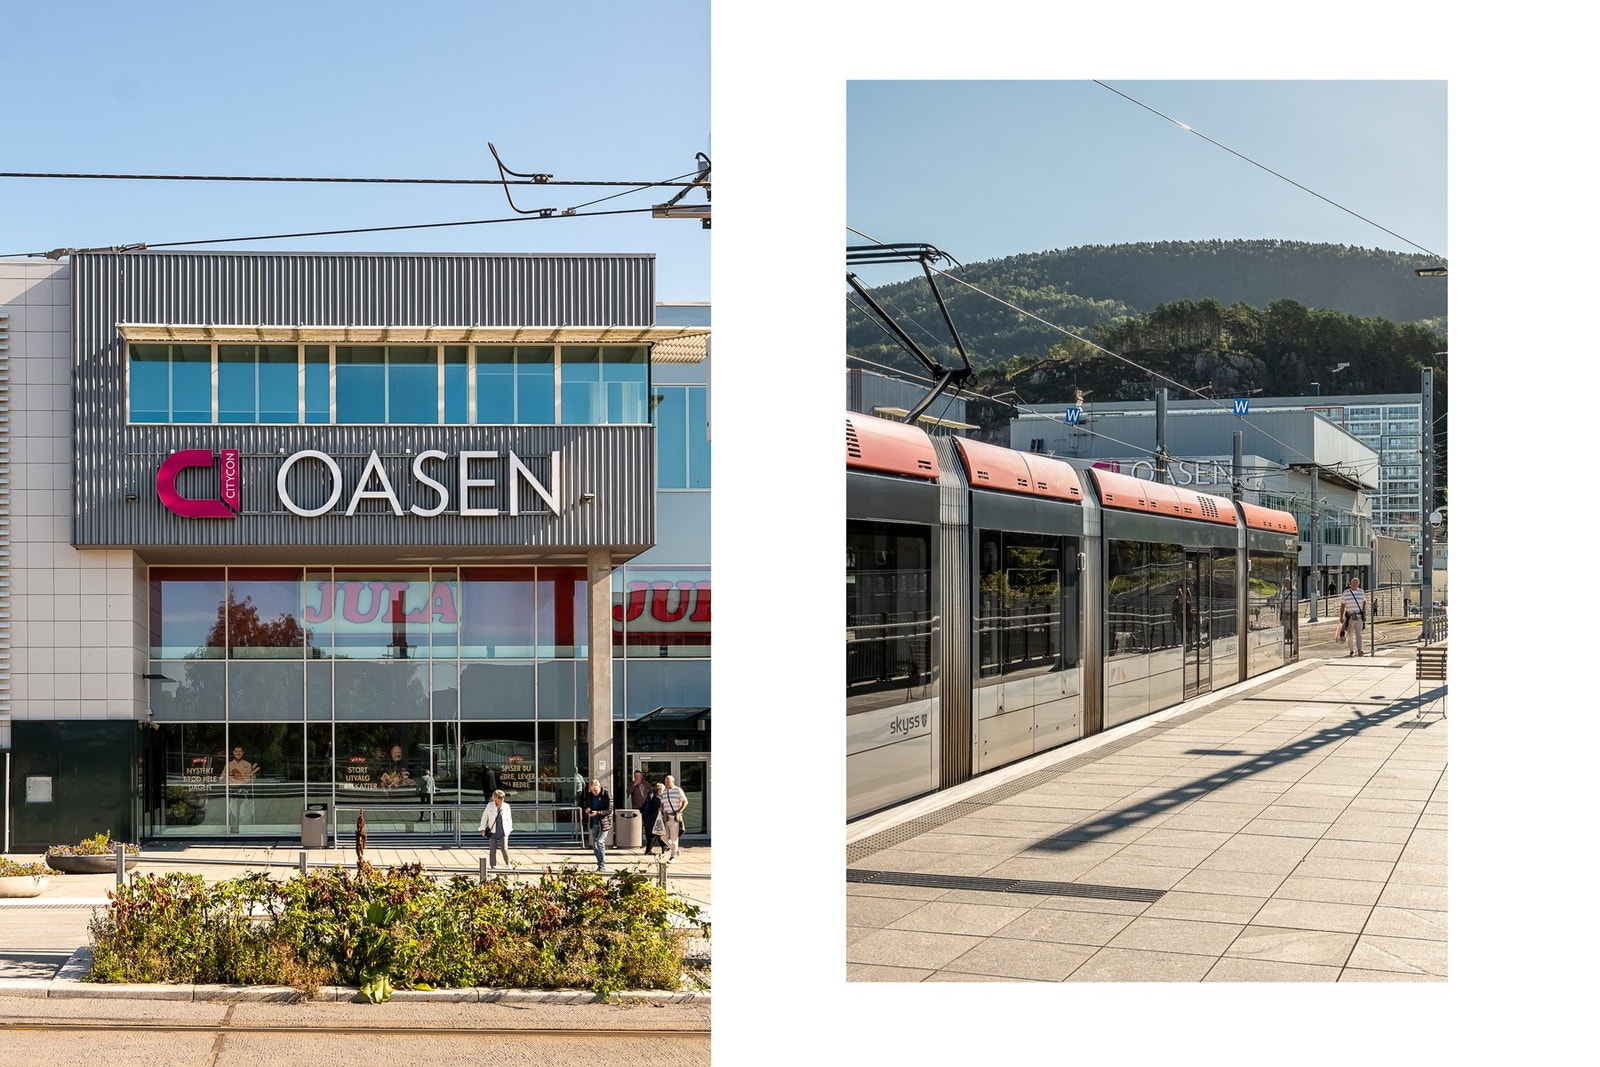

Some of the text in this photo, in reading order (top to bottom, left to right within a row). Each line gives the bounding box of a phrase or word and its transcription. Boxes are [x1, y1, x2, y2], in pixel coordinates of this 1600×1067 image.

[1235, 400, 1248, 414] W
[1067, 409, 1079, 422] W
[225, 452, 236, 499] CITYCON
[276, 449, 560, 517] OASEN
[302, 581, 459, 624] JULA
[890, 715, 920, 735] skyss
[186, 767, 214, 775] NYSTEKT
[347, 766, 368, 774] STORT
[501, 764, 521, 772] SPISER
[345, 774, 371, 782] UTVALG
[188, 784, 212, 792] DAGEN
